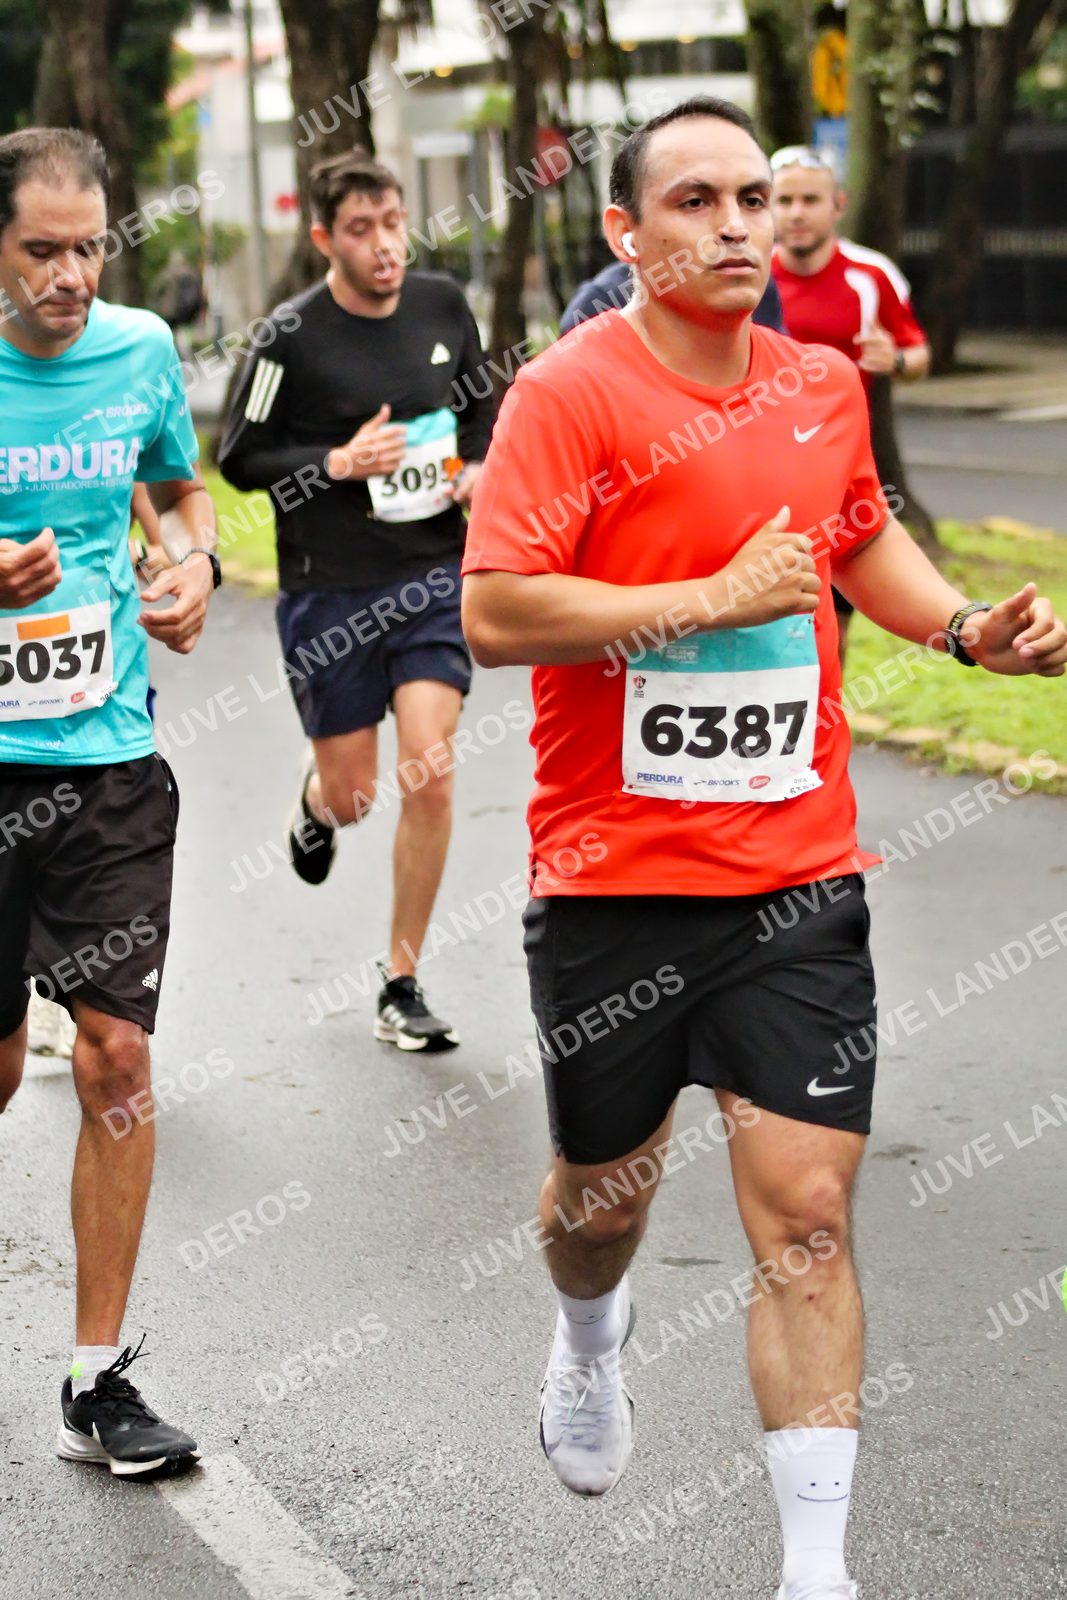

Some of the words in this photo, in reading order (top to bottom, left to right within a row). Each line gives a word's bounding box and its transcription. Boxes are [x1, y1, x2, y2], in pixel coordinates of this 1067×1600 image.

[641, 700, 808, 759] 6387
[637, 772, 684, 785] PERDURA
[707, 779, 740, 787] BROOKS
